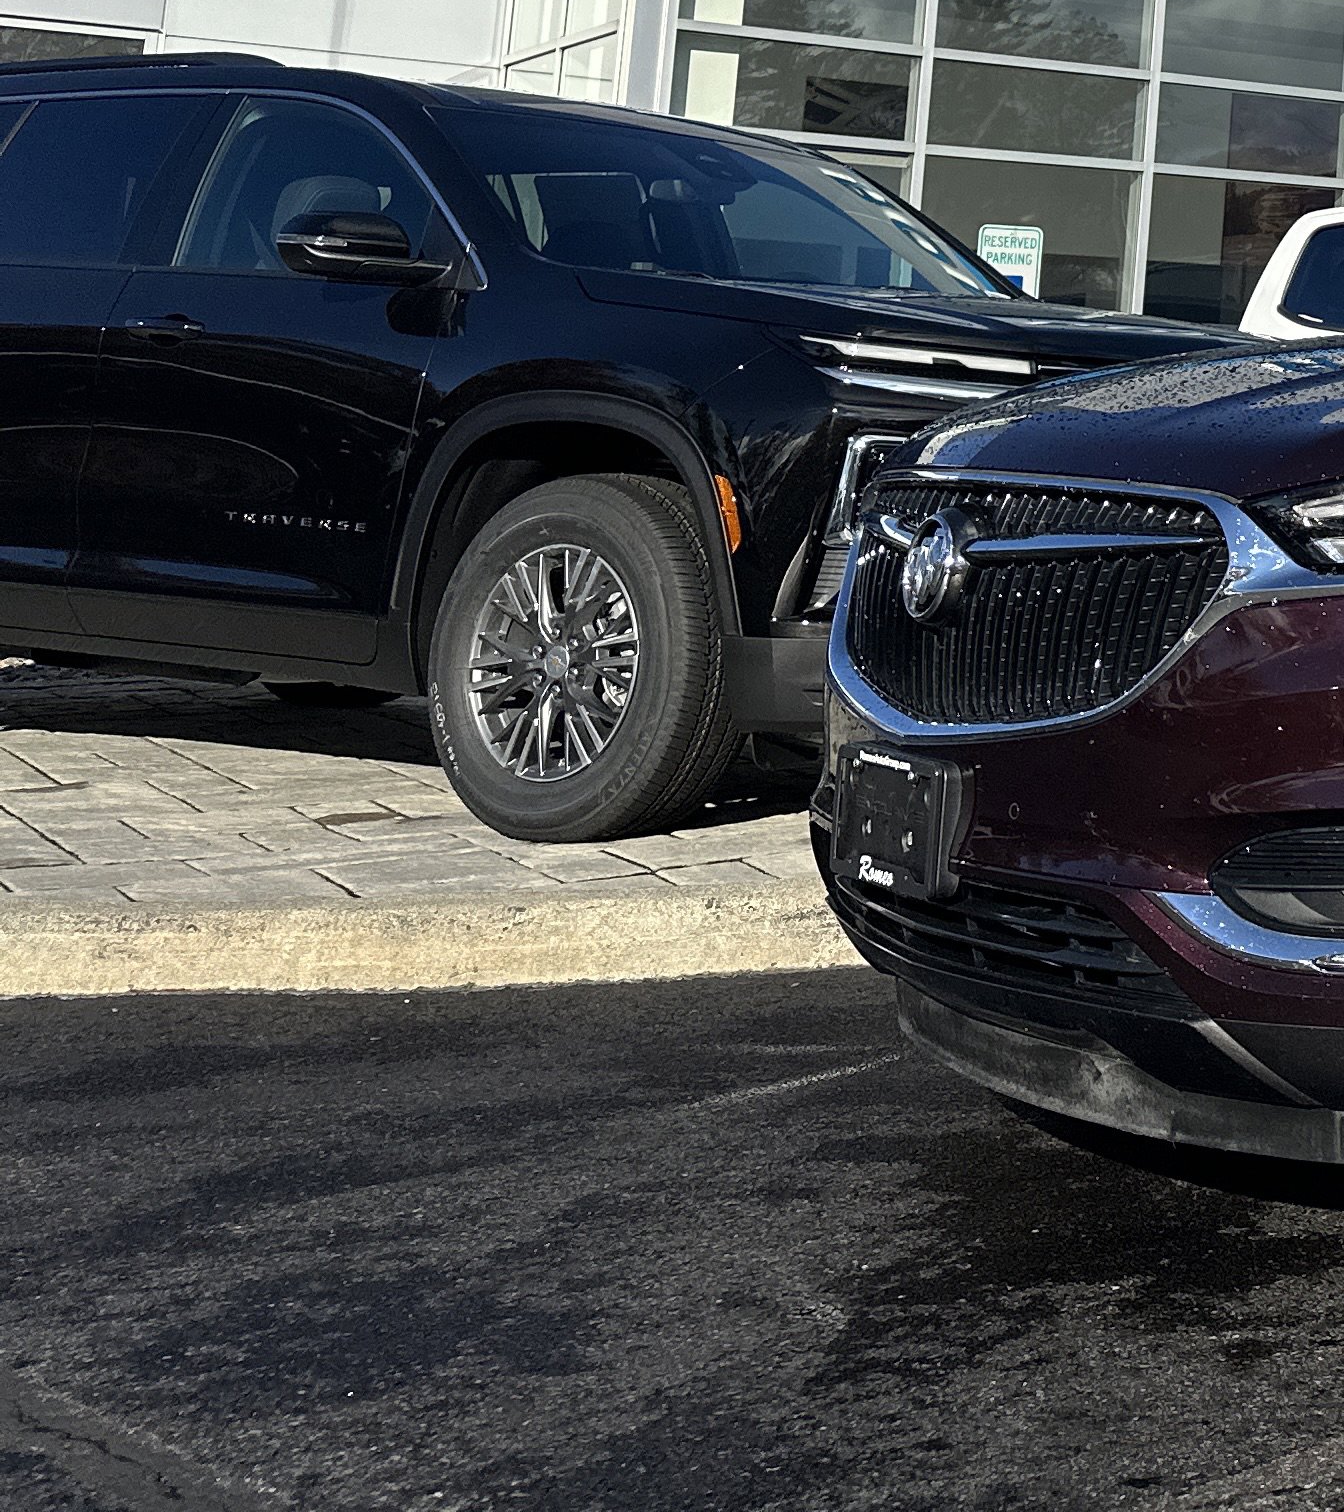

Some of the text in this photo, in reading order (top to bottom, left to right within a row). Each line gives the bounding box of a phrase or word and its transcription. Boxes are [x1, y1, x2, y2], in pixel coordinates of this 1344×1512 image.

[984, 235, 1037, 249] RESERVED
[986, 252, 1033, 265] PARKING
[224, 511, 367, 533] TRAVERSE
